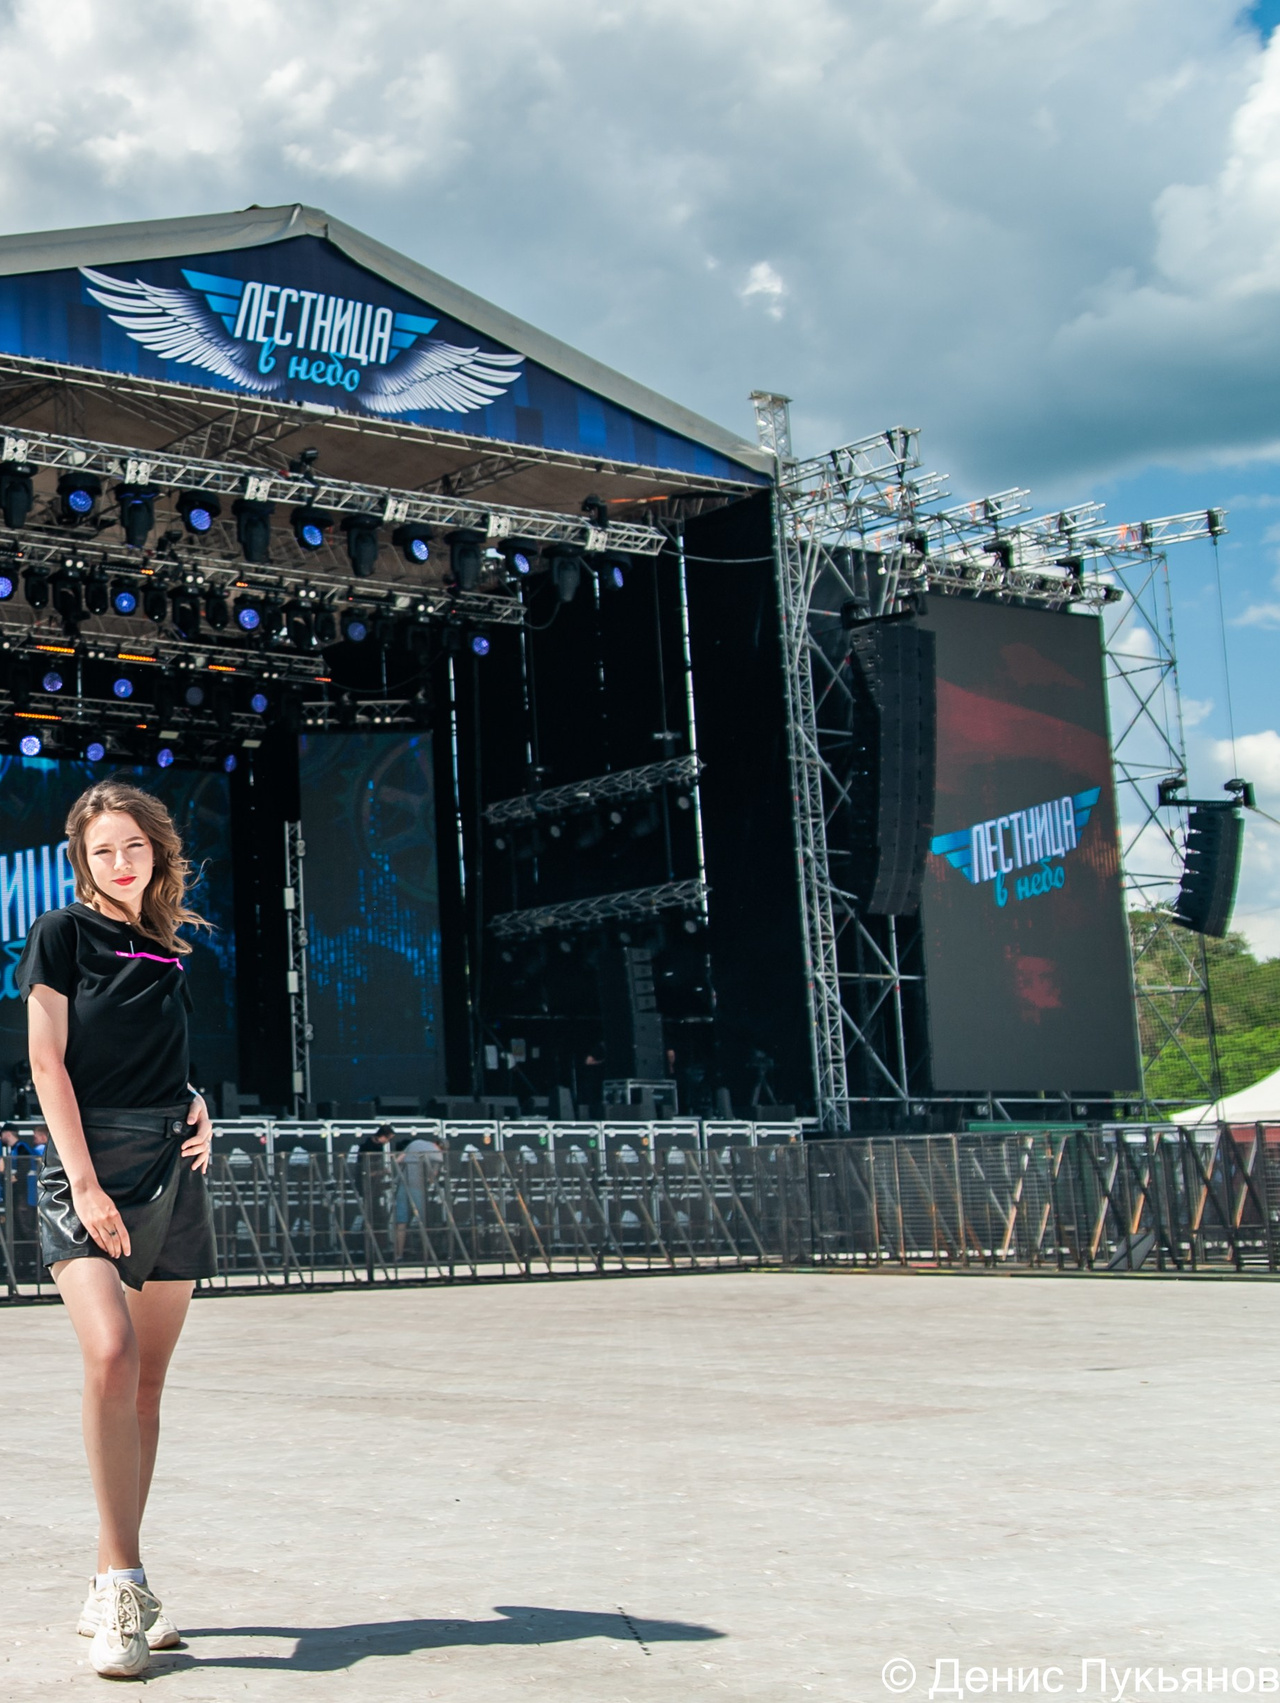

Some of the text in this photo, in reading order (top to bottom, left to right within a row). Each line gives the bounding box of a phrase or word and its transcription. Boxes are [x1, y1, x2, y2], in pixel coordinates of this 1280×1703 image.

[234, 281, 393, 366] ЛЕСТНИЦА
[257, 337, 361, 392] в небо
[971, 796, 1077, 884] ЛЕСТНИЦА
[994, 856, 1065, 908] в небо
